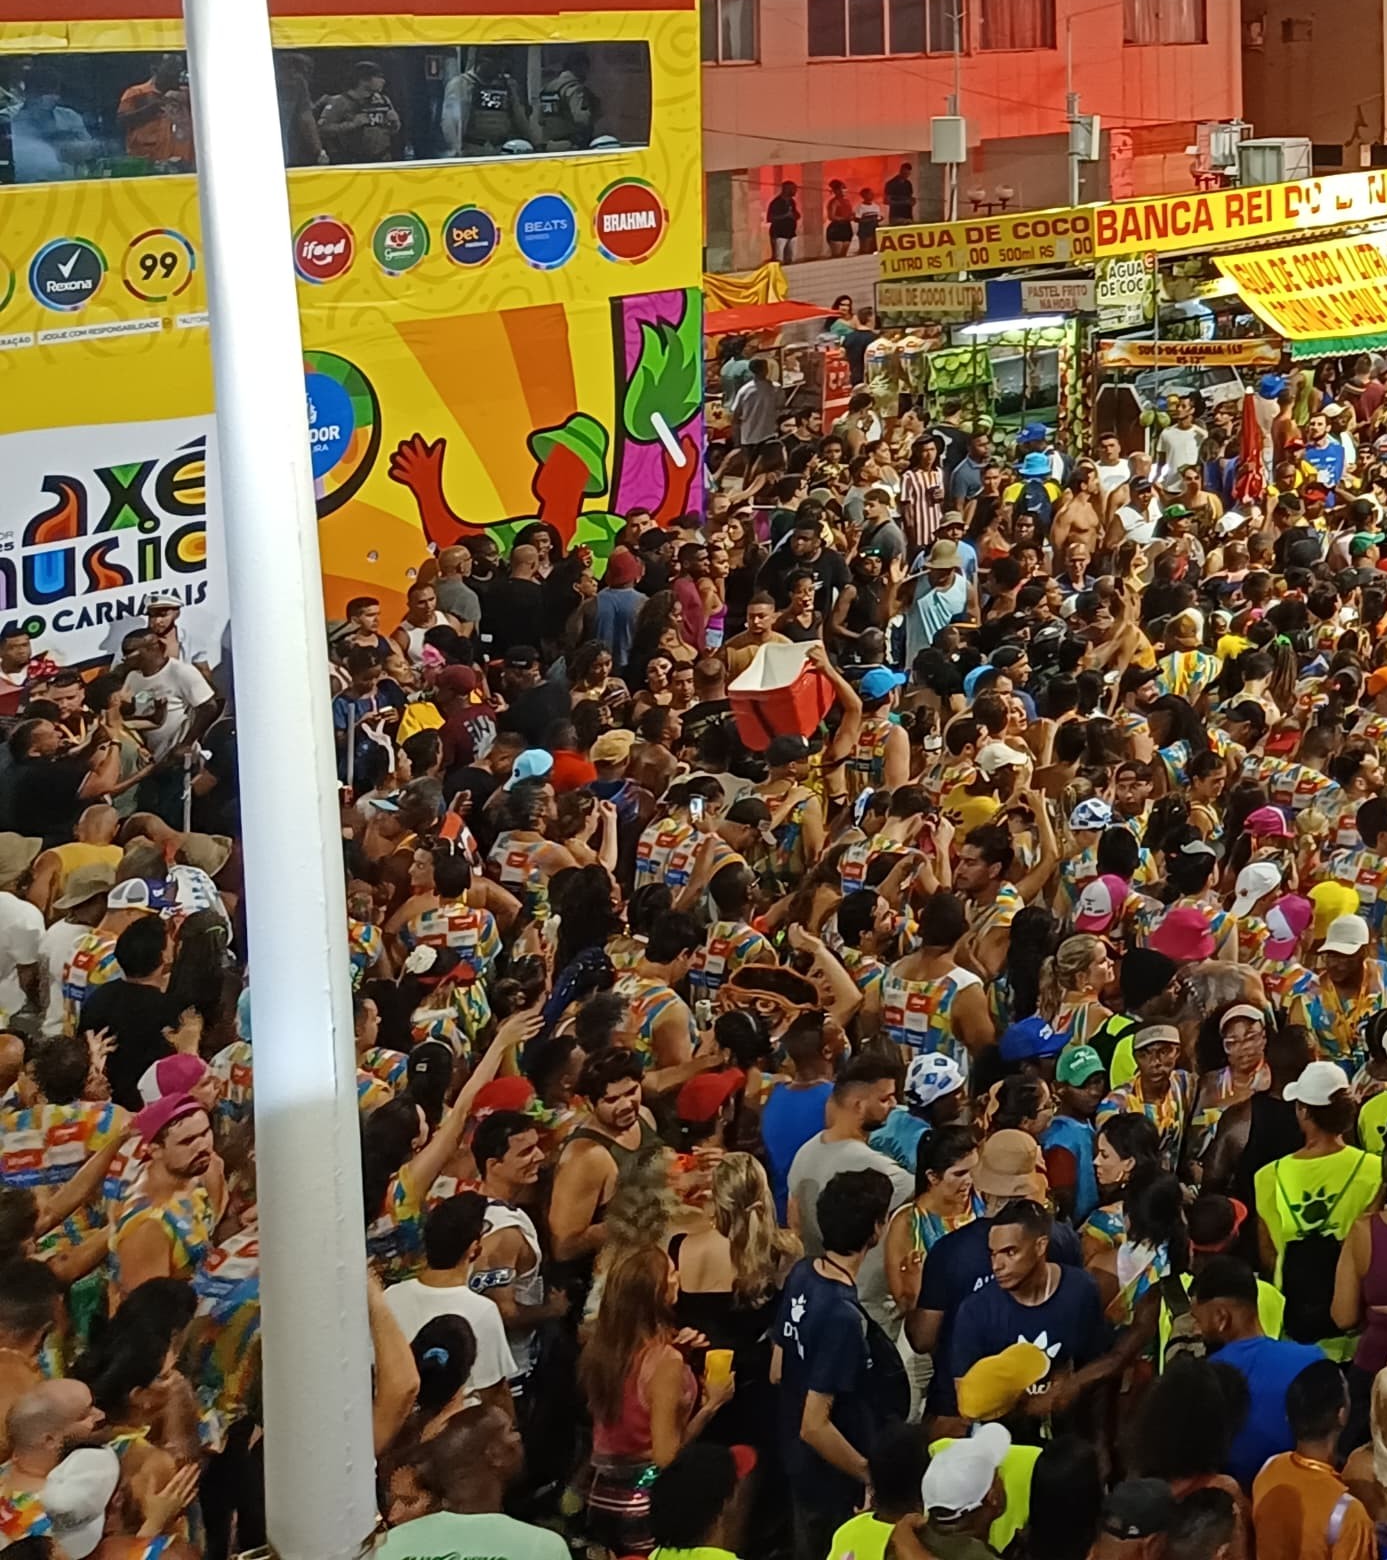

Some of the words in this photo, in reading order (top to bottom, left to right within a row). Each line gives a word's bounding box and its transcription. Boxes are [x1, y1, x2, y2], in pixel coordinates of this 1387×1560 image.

[524, 219, 568, 233] BEATS
[603, 210, 656, 233] BRAHMA
[1096, 199, 1213, 246] BANCA
[1225, 188, 1273, 227] REI
[452, 226, 479, 241] bet
[880, 228, 956, 253] ÁGUA
[965, 224, 1001, 245] DE
[1012, 216, 1090, 239] COCO
[302, 238, 345, 257] ifood
[139, 252, 178, 281] 99
[880, 262, 887, 272] 1
[891, 256, 922, 272] LITRO
[945, 246, 989, 269] 1,00
[1292, 250, 1342, 289] COCO
[46, 279, 92, 293] Rexona
[1028, 285, 1060, 298] PASTEL
[1061, 284, 1087, 296] FRITO
[1101, 283, 1116, 297] DE
[921, 287, 945, 306] COCO
[68, 329, 88, 338] COM
[22, 435, 207, 548] axé
